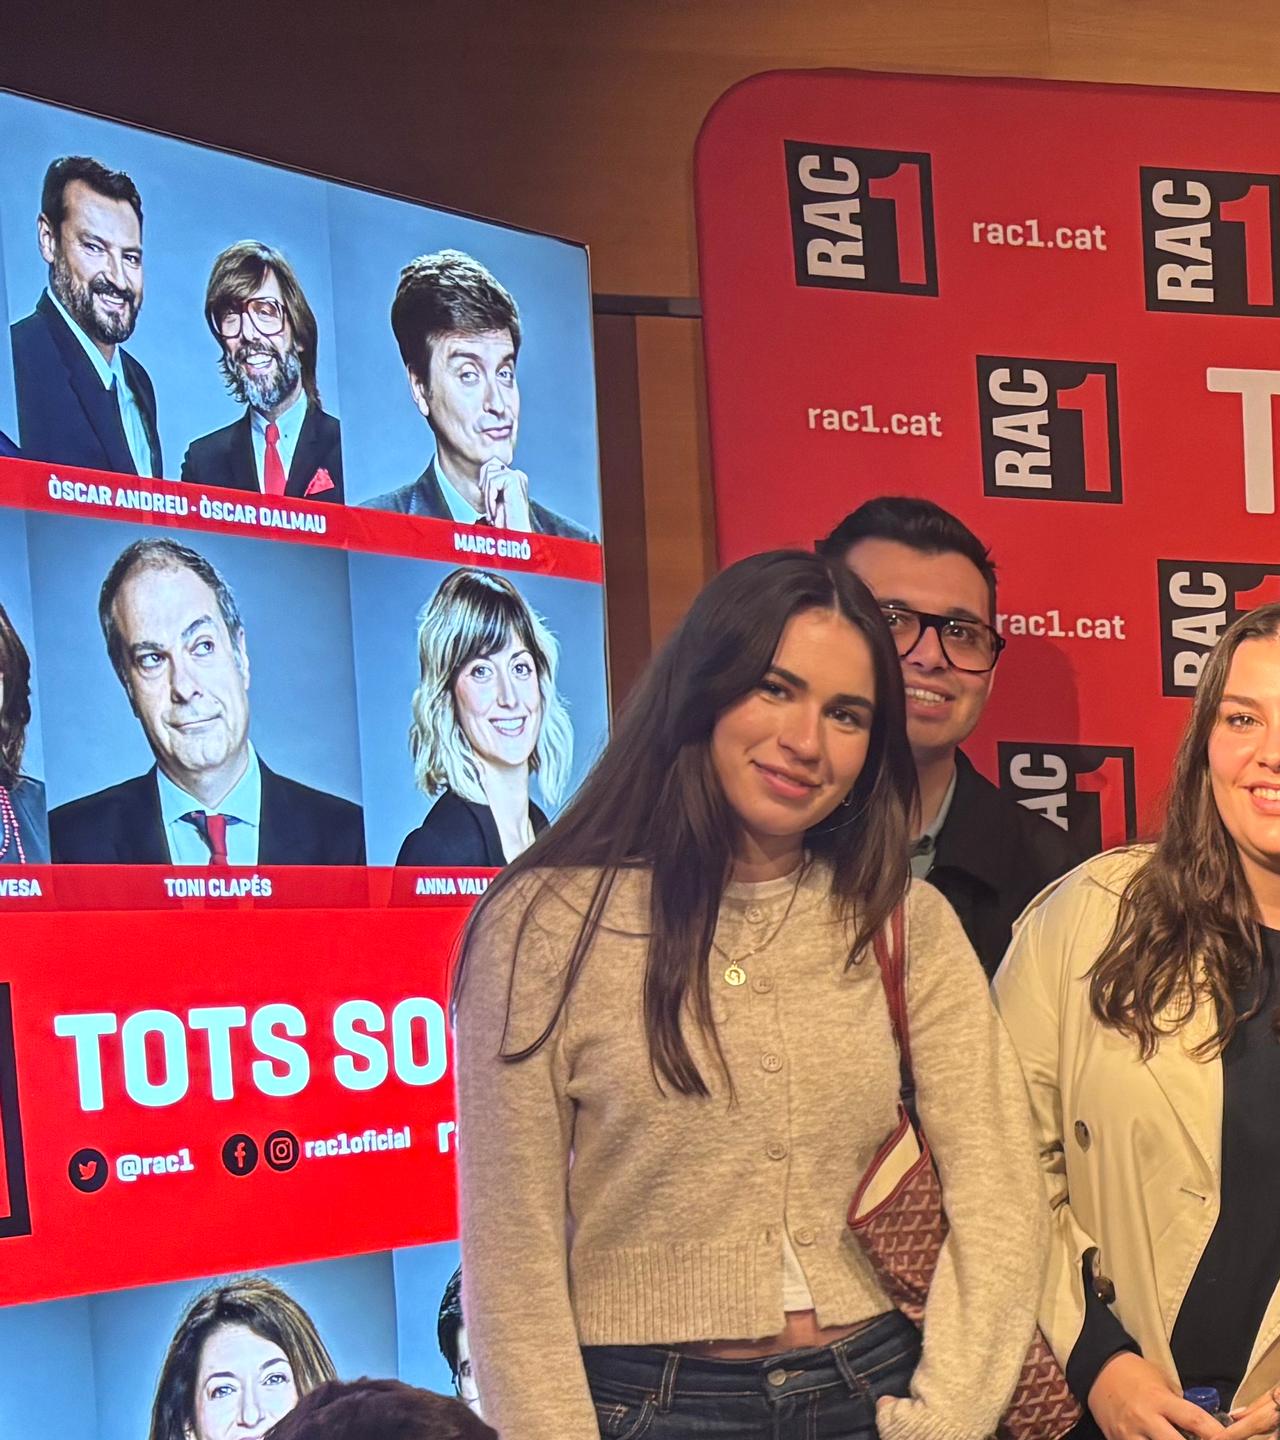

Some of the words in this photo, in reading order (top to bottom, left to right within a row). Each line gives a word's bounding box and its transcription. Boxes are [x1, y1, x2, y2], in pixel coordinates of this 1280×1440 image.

[797, 153, 866, 281] RAC
[867, 161, 926, 286] 1
[971, 216, 1108, 252] rac1.cat
[1152, 178, 1215, 304] RAC
[1219, 184, 1275, 307] 1
[806, 403, 944, 439] rac1.cat
[987, 366, 1053, 490] RAC
[1056, 372, 1113, 493] 1
[48, 472, 112, 507] ÒSCAR
[115, 485, 188, 516] ANDREU
[200, 491, 257, 525] ÒSCAR
[259, 504, 327, 534] DALMAU
[453, 531, 493, 555] MARC
[496, 533, 531, 561] GIRÓ
[996, 609, 1126, 641] rac1.cat
[164, 877, 205, 898] TONI
[208, 873, 273, 897] CLAPÉS
[415, 877, 456, 896] ANNA
[53, 1002, 311, 1112] TOTS
[304, 1125, 411, 1159] rac1oficial
[115, 1148, 195, 1183] @rac1
